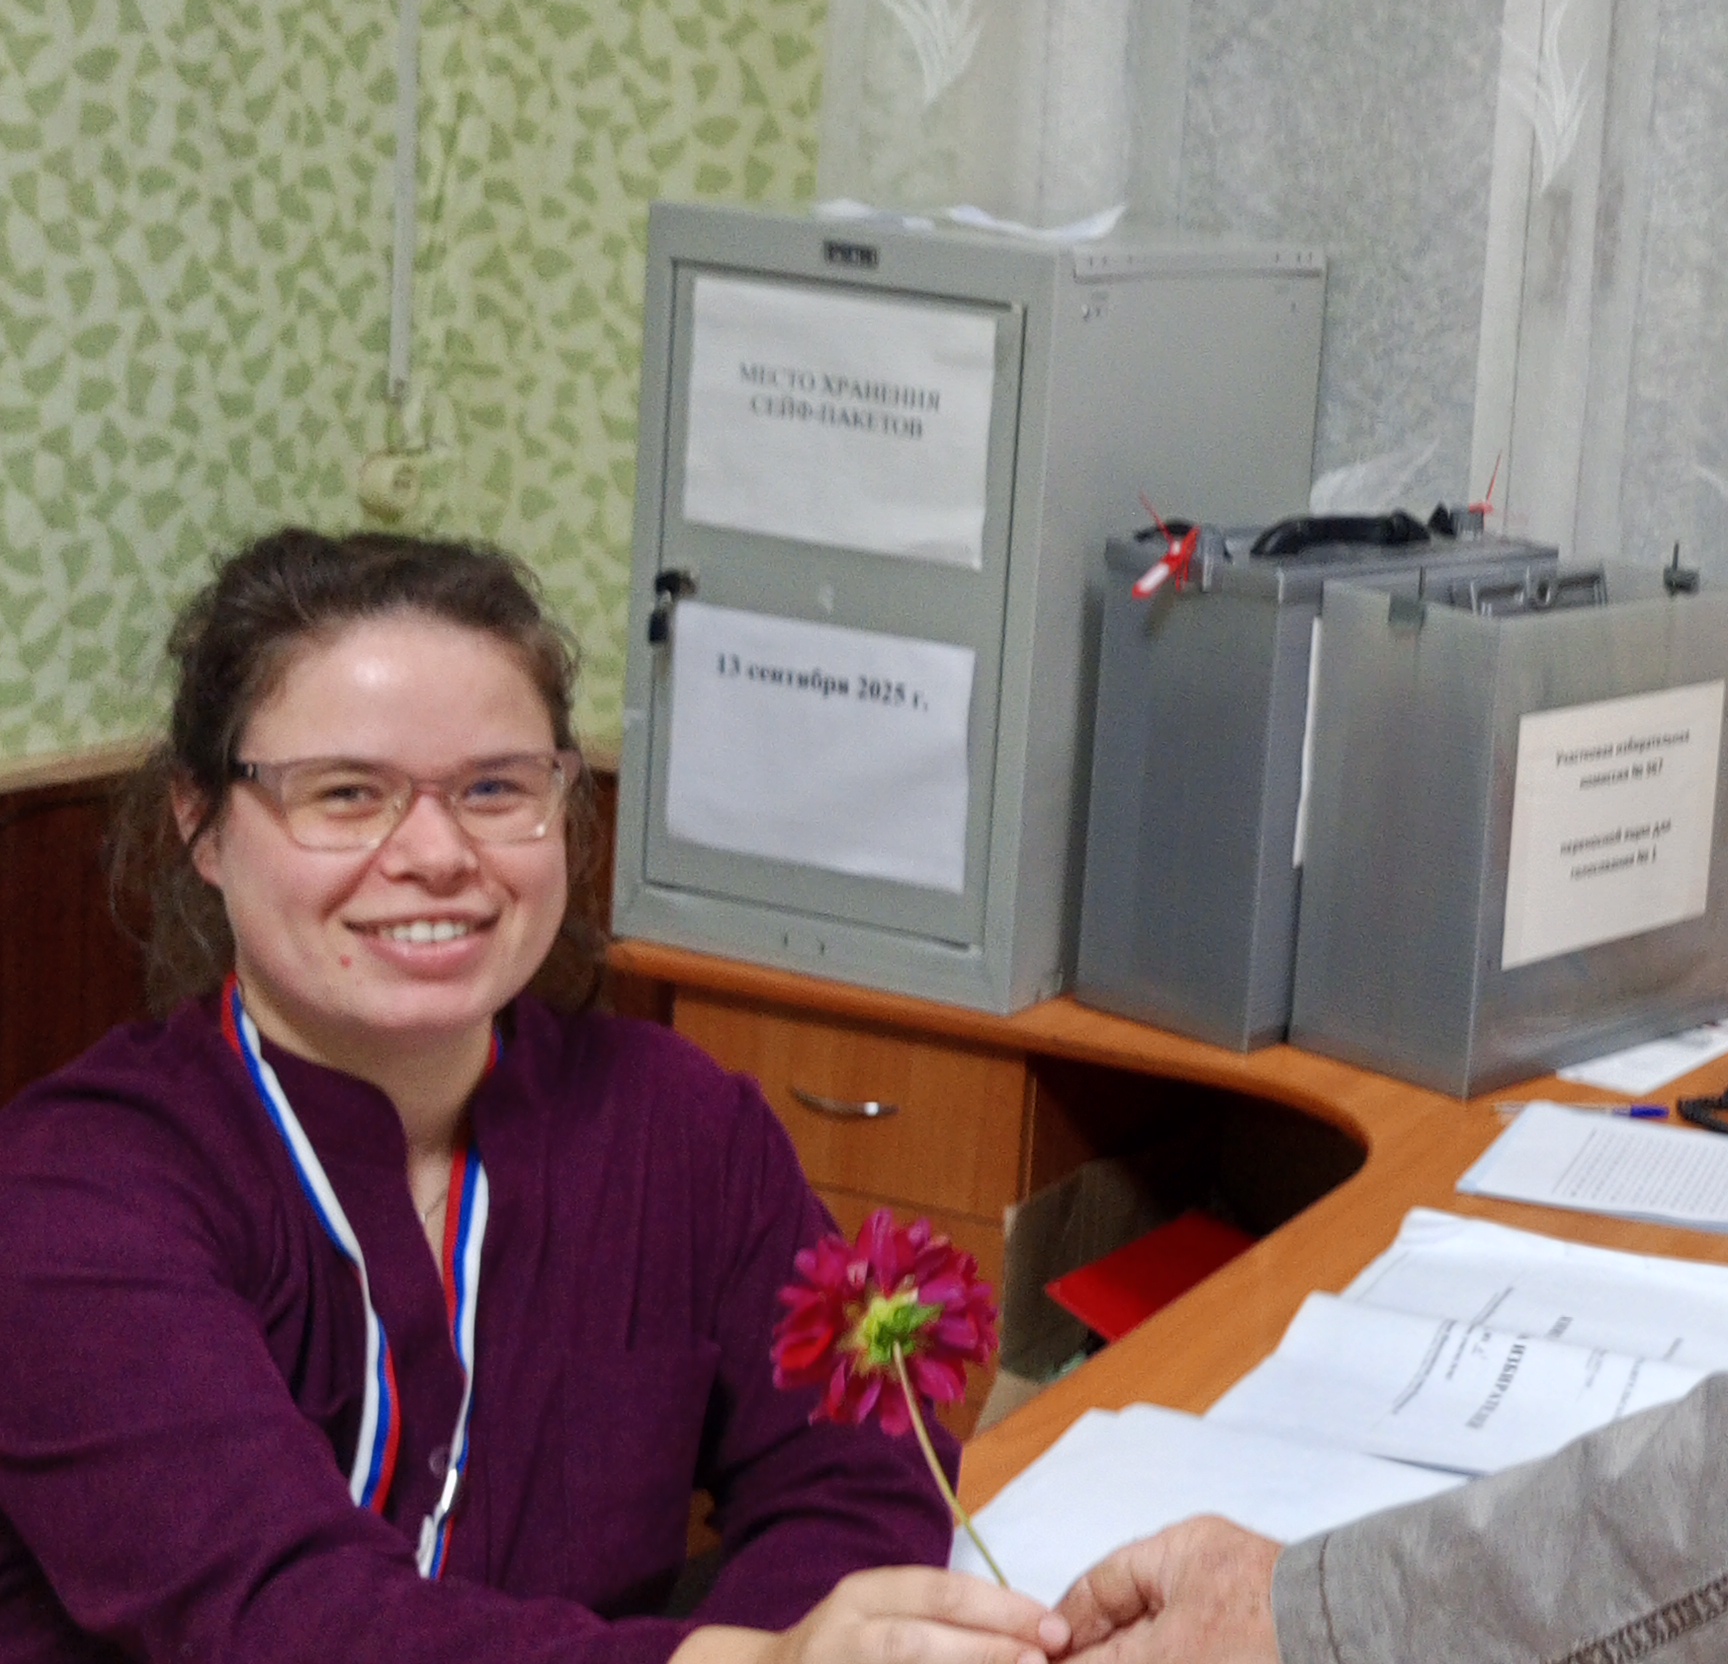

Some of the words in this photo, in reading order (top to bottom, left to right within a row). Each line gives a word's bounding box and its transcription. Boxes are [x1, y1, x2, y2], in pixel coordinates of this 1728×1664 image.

[740, 361, 816, 390] МЕСТО
[822, 373, 940, 412] ХРАНЕНИЯ
[716, 652, 741, 677] 13
[747, 664, 850, 699] сентября
[857, 674, 905, 705] 2025
[912, 690, 929, 712] г.
